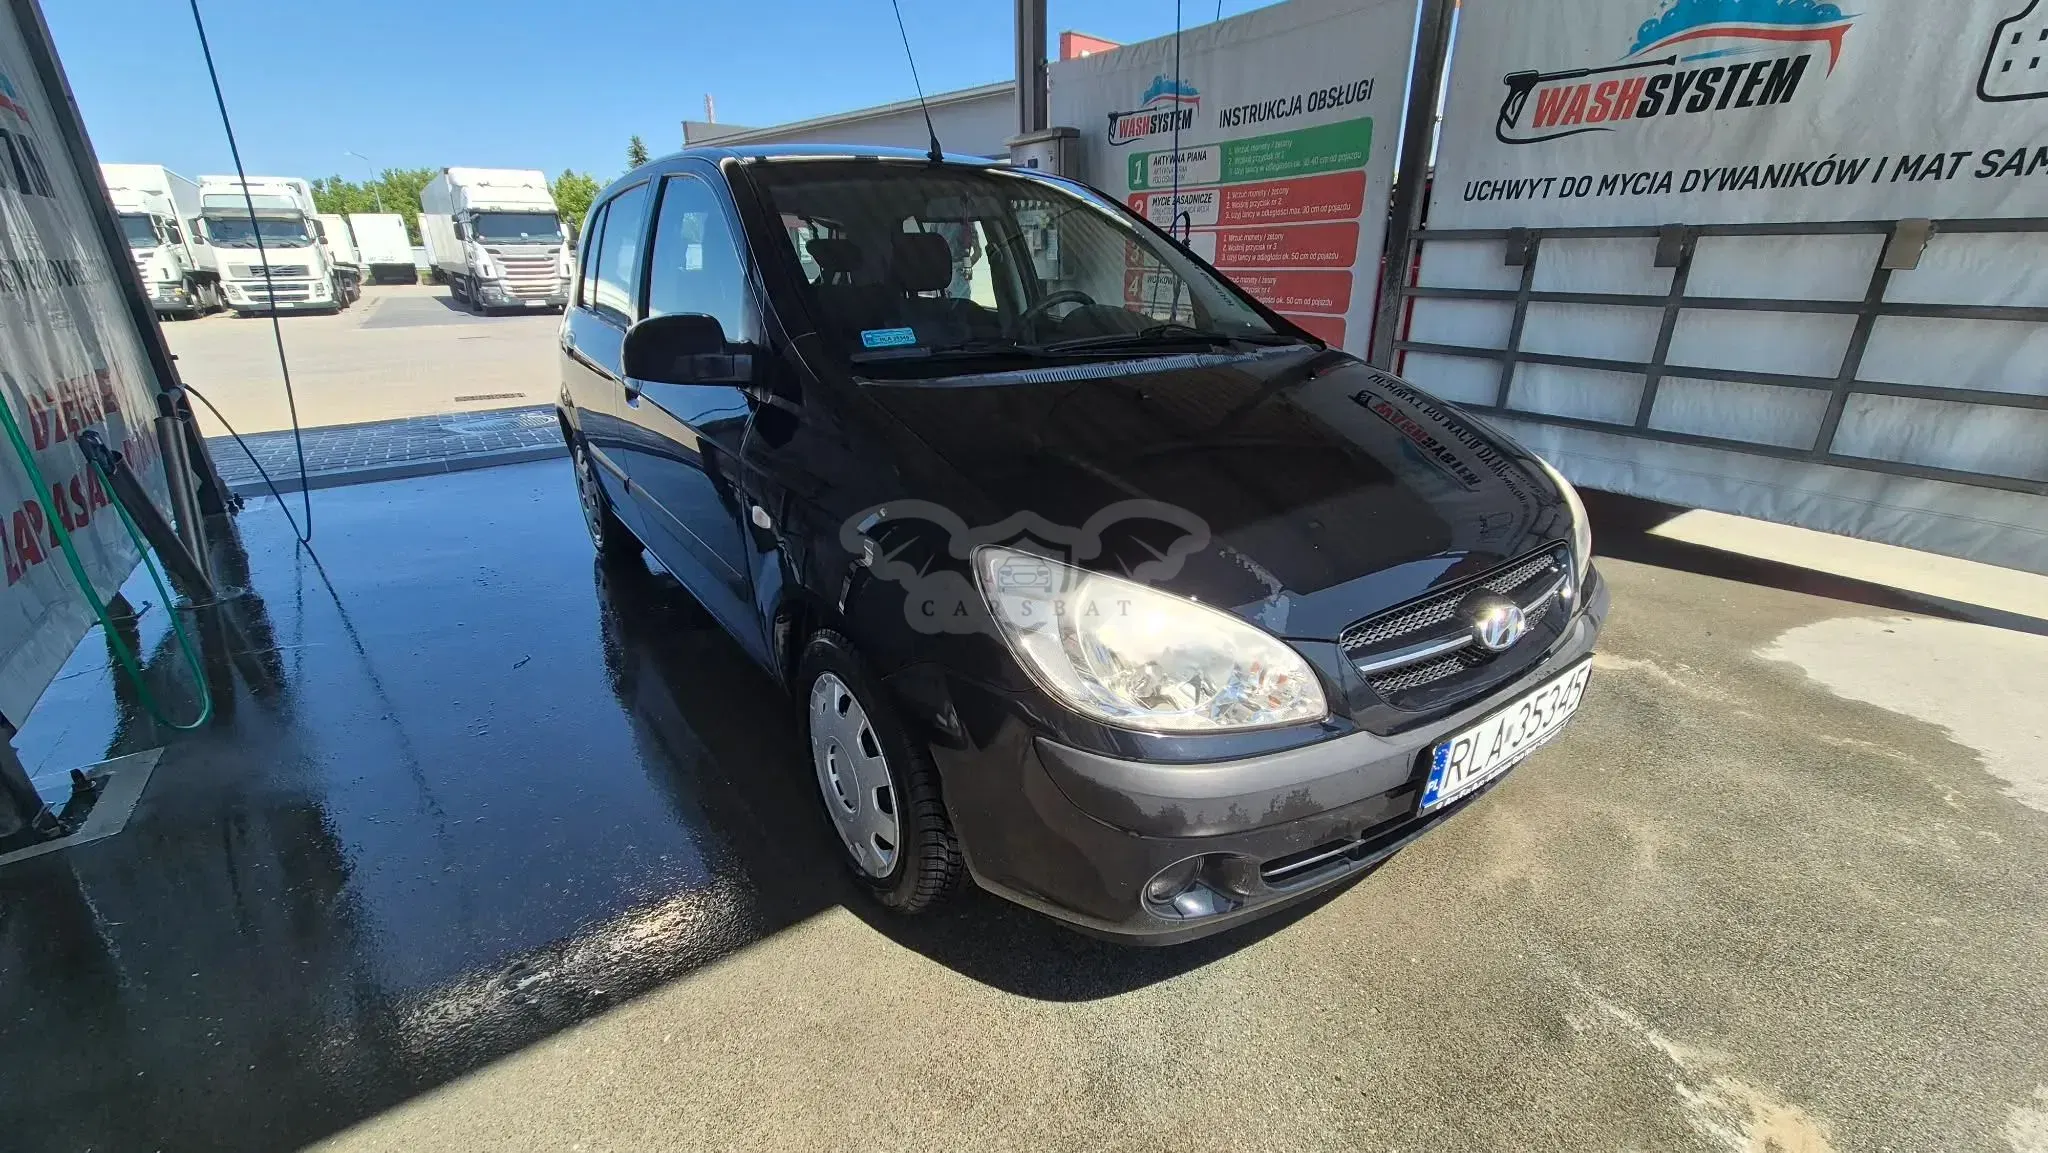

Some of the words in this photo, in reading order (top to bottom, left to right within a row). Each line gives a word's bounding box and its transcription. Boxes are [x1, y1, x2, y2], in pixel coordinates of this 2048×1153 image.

[1532, 54, 1812, 129] WASHSYSTEM
[1219, 95, 1302, 128] INSTRUKCJA
[1307, 78, 1374, 112] OBSŁUGI
[1119, 108, 1193, 139] WASHSYSTEM
[1187, 150, 1207, 162] PIANA
[1134, 160, 1142, 185] 1
[1463, 177, 1557, 202] UCHWYT
[1558, 175, 1593, 199] DO
[1596, 171, 1673, 197] MYCIA
[1679, 153, 1871, 193] DYWANIKÓW
[1871, 157, 1888, 182] I
[1890, 152, 1972, 182] MAT
[1152, 196, 1171, 206] MYCIE
[1172, 193, 1213, 206] ZASADNICZE
[1320, 204, 1328, 212] od
[1328, 203, 1352, 213] pojazdu
[1291, 252, 1300, 260] 50
[1300, 252, 1309, 260] cm
[1309, 251, 1317, 260] od
[1317, 251, 1339, 261] pojazdu
[1128, 276, 1139, 297] 4
[1286, 296, 1294, 305] 50
[1294, 297, 1303, 305] cm
[1303, 296, 1311, 305] od
[1311, 296, 1333, 306] pojazdu
[1444, 717, 1506, 789] RLA
[1512, 665, 1587, 748] 35345
[1426, 778, 1440, 795] PL
